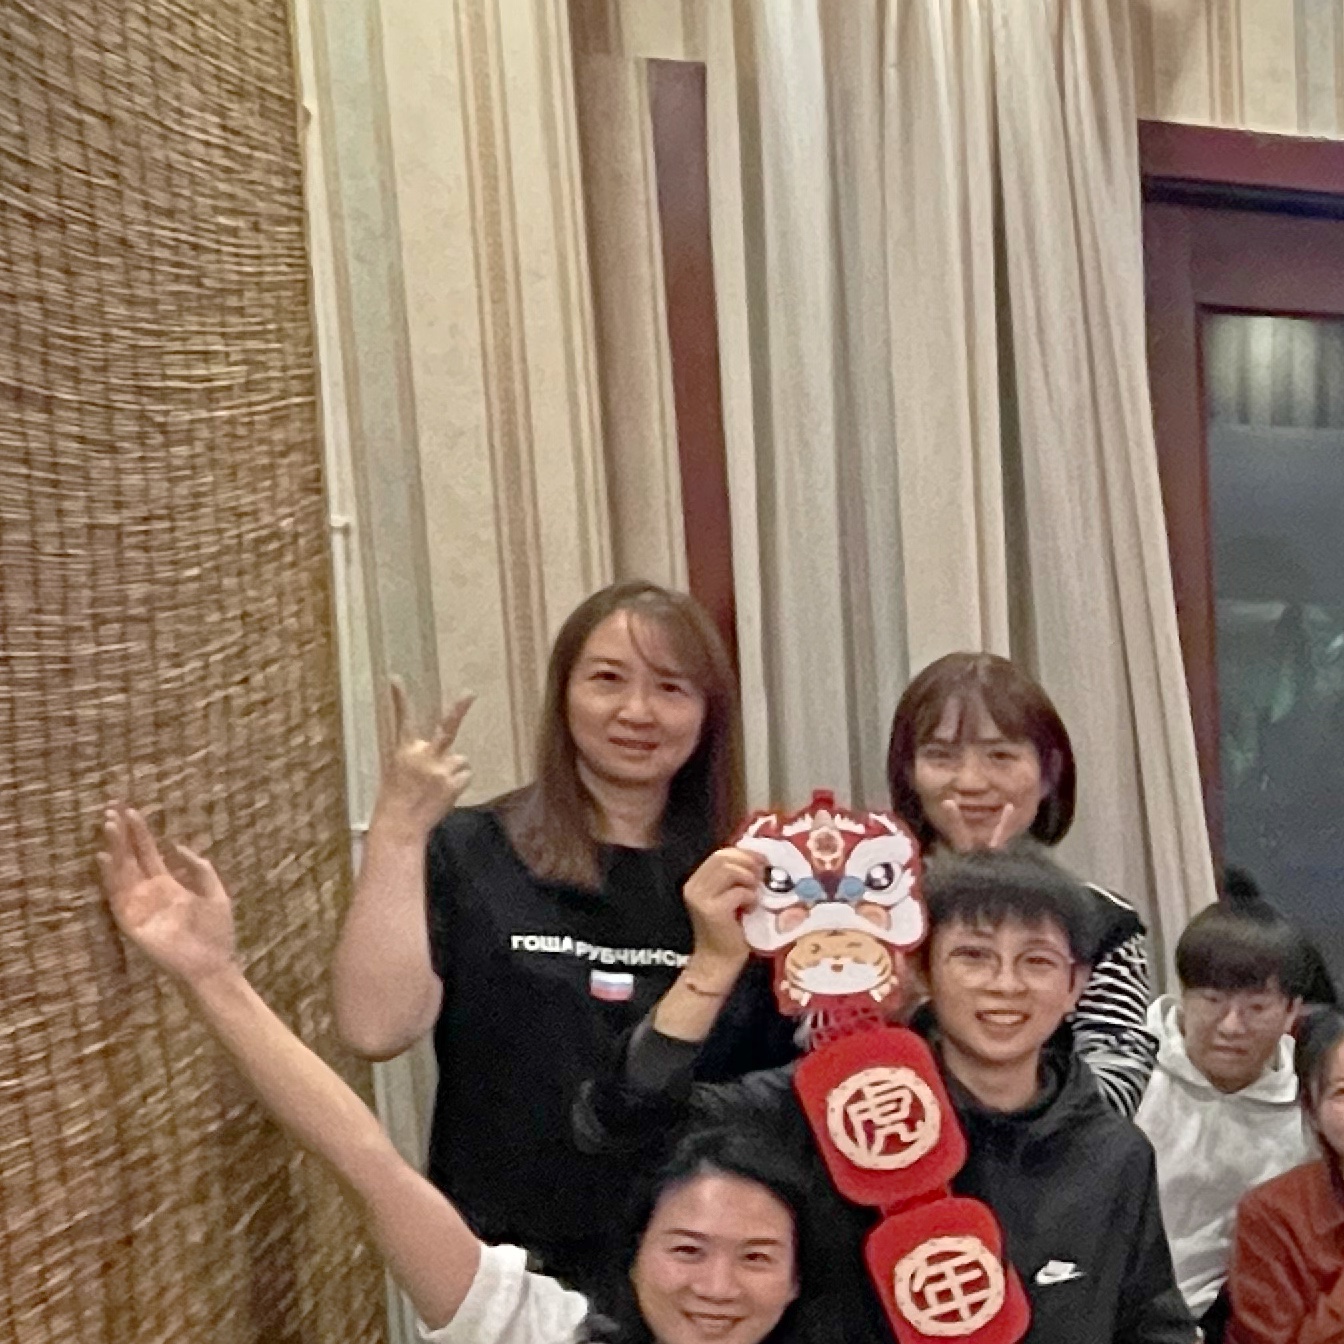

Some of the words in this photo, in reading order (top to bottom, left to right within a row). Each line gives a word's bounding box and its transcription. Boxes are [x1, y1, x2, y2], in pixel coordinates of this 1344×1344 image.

[511, 935, 573, 952] ГОША
[844, 1079, 929, 1156] 虎
[909, 1251, 991, 1324] 年
